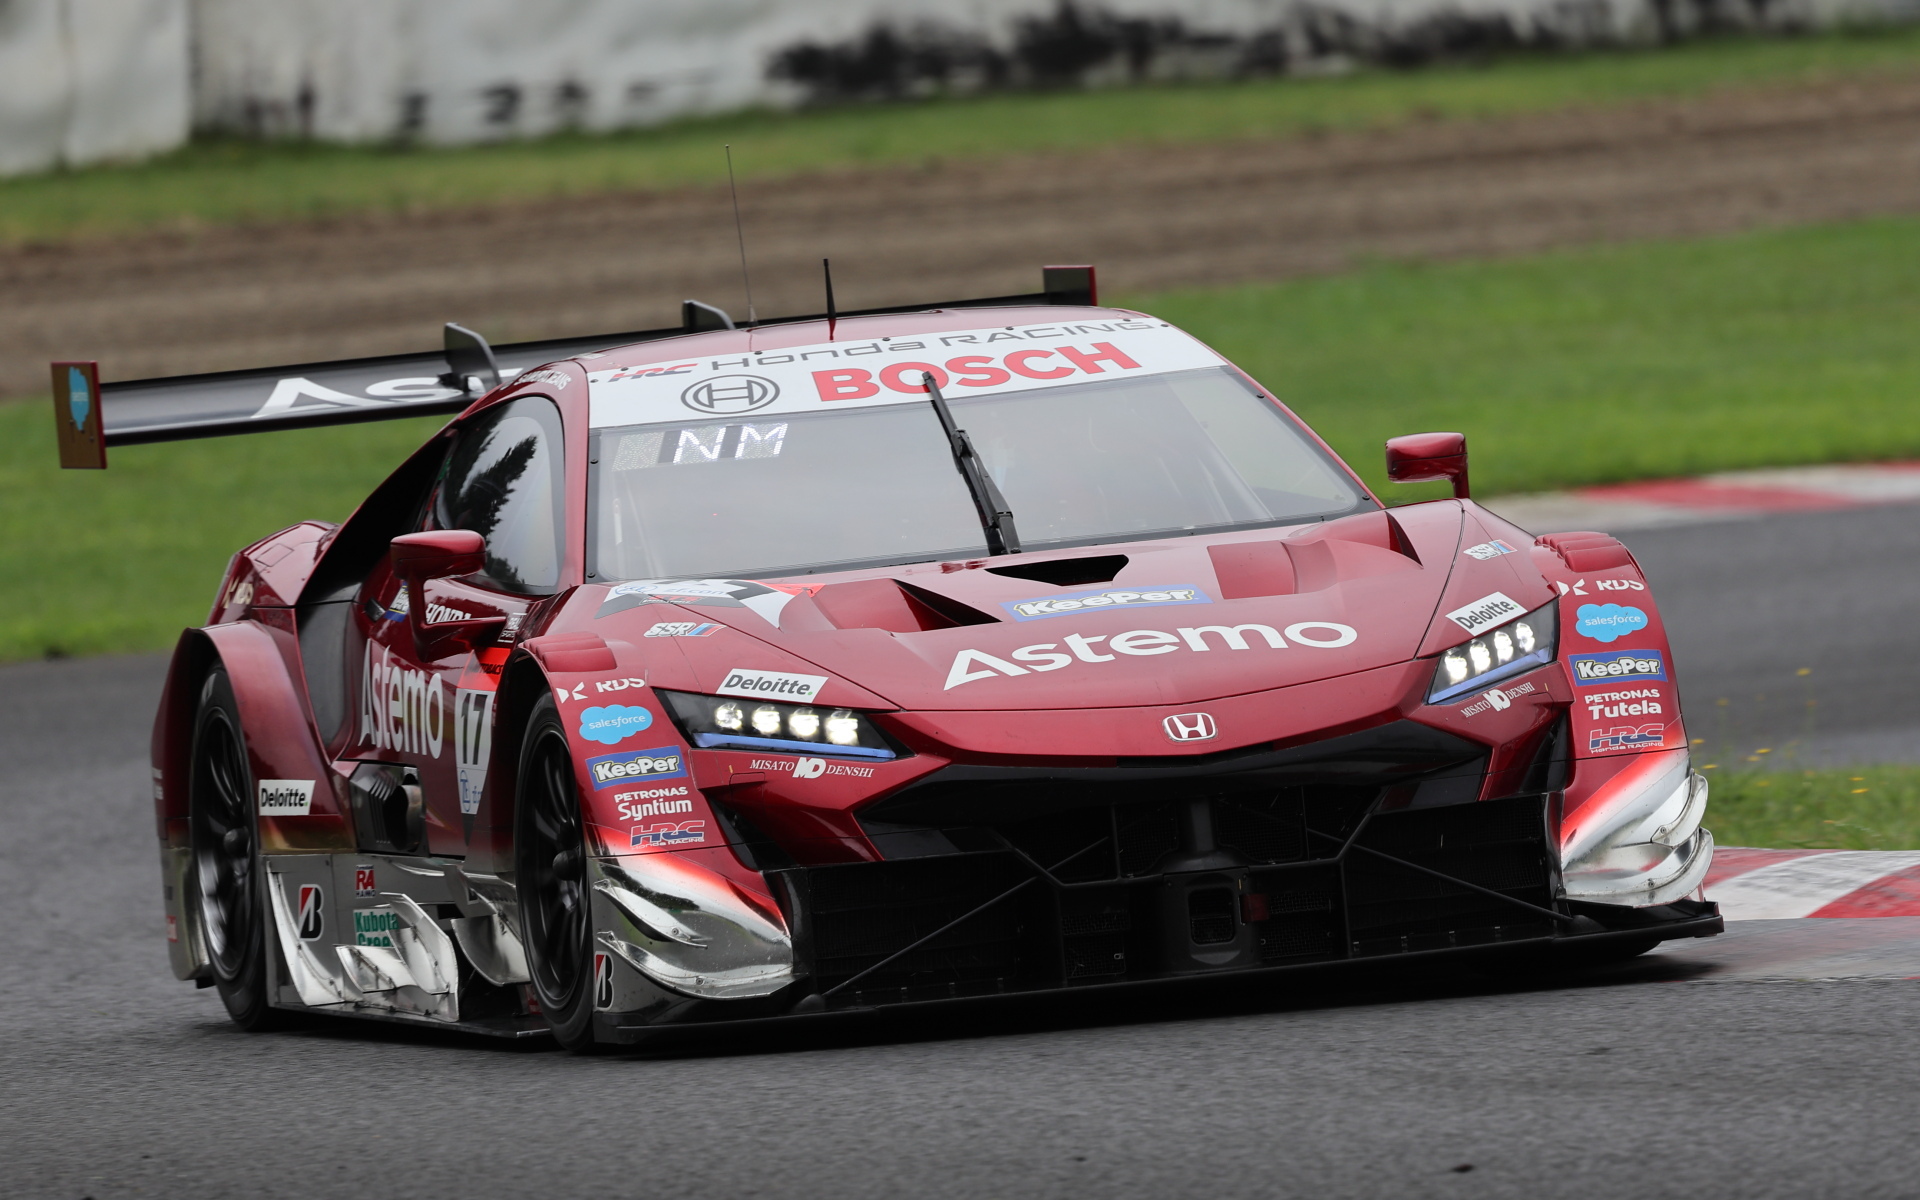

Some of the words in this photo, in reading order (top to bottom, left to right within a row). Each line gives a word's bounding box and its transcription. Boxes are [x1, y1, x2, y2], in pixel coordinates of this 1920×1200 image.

[608, 363, 698, 382] HRC
[712, 341, 926, 371] Honda
[939, 321, 1154, 347] RACING
[811, 342, 1143, 402] BOSCH
[1018, 590, 1190, 616] KeePer
[643, 622, 697, 637] SSR
[1585, 615, 1641, 626] salesforce
[943, 621, 1358, 691] Astemo
[1577, 658, 1659, 678] KeePer
[358, 637, 444, 759] Astemo
[1460, 700, 1492, 718] MISATO
[1505, 682, 1535, 699] DENSHI
[1584, 689, 1660, 704] PETRONAS
[1588, 700, 1662, 720] Tutela
[461, 692, 489, 765] 17
[588, 715, 646, 730] salesforce
[1589, 723, 1664, 750] HRC
[1590, 744, 1626, 754] Honda
[1627, 741, 1664, 749] RACING
[595, 756, 679, 781] KeePer
[749, 759, 795, 771] MISATO
[826, 765, 875, 778] DENSHI
[614, 786, 688, 803] PETRONAS
[618, 797, 692, 821] Syntium
[630, 819, 705, 847] HRC
[668, 836, 705, 846] RACING
[354, 911, 399, 933] Kubota
